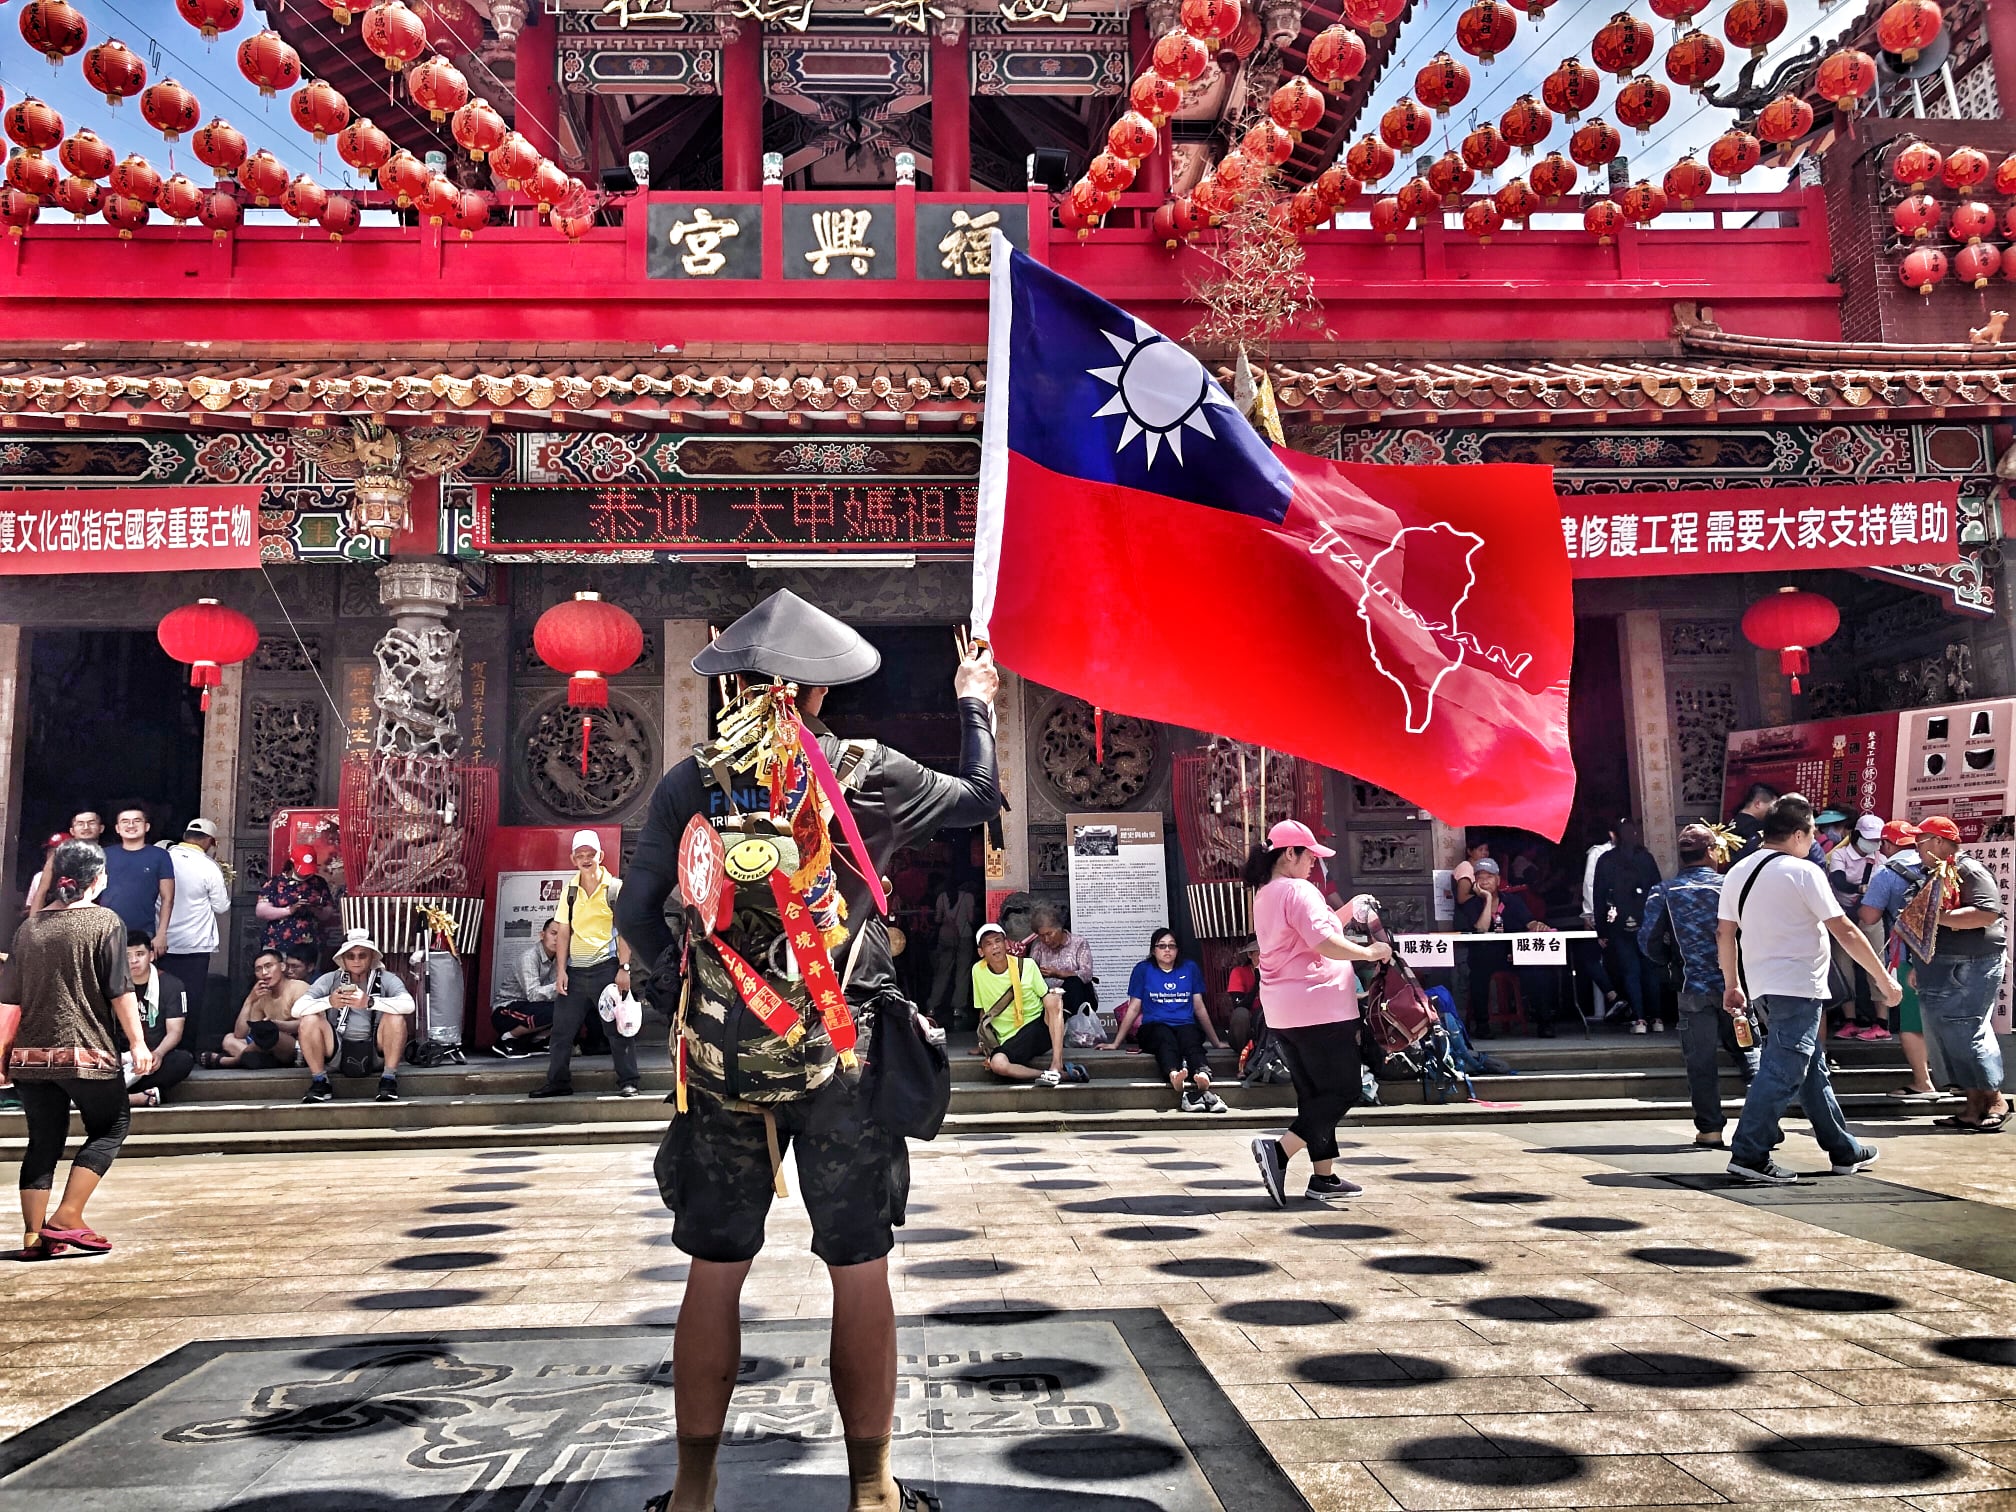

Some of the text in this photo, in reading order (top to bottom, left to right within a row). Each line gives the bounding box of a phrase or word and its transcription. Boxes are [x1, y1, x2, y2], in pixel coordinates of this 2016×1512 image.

[589, 489, 701, 542] 恭迎
[1706, 500, 1948, 554] 需要大家支持贊助
[784, 901, 838, 1006] 合境平安
[1404, 940, 1448, 954] 服務台
[1516, 938, 1561, 952] 服務台
